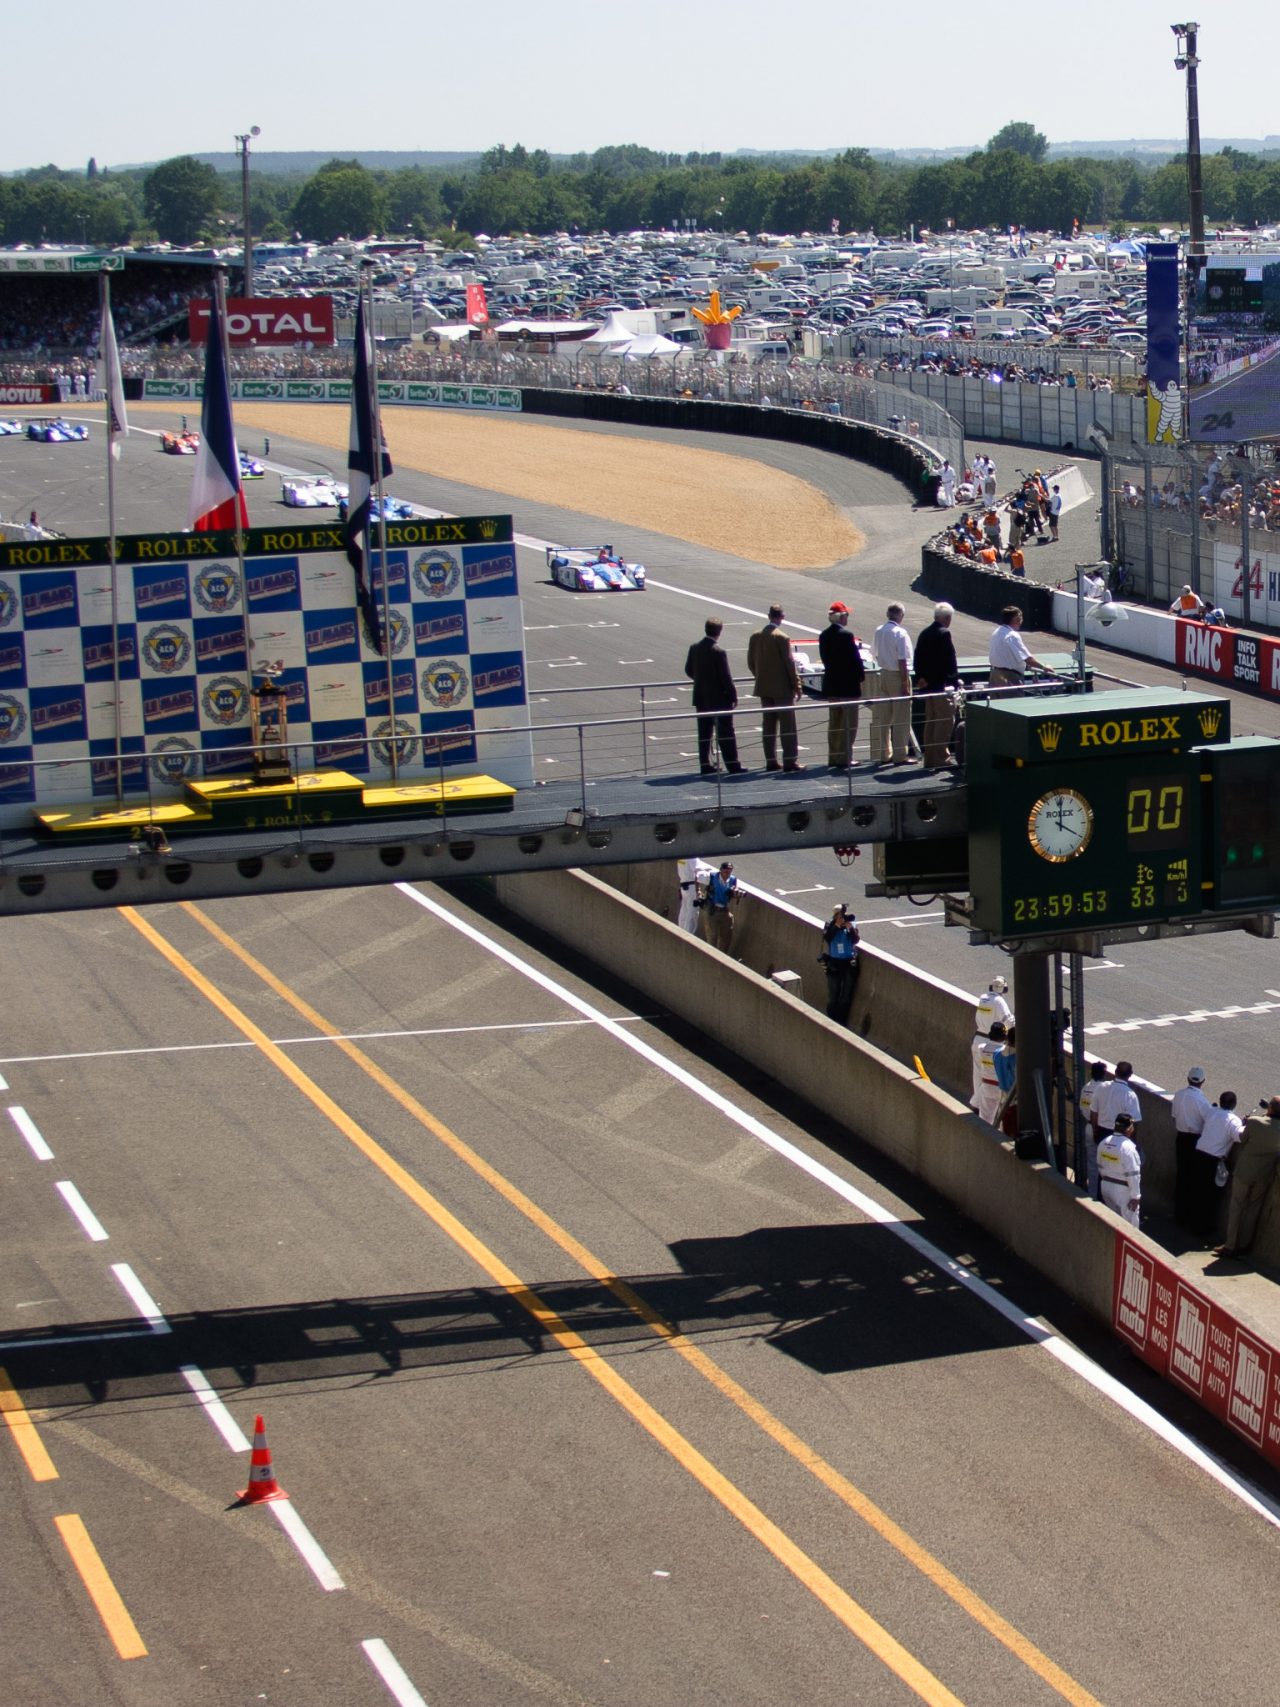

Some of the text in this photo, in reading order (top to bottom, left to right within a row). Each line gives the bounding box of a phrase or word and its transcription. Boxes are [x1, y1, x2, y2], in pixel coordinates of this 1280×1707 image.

[8, 523, 467, 565] ROLEX ROLEX ROLEX ROLEX
[1231, 556, 1264, 600] 24
[1184, 624, 1222, 673] RMC
[1238, 640, 1256, 655] INFO
[1238, 653, 1256, 669] TALK
[1234, 666, 1260, 683] SPORT
[1080, 716, 1181, 746] ROLEX
[286, 796, 292, 810] 1
[1046, 808, 1074, 818] ROLEX
[1127, 786, 1183, 834] 00
[264, 813, 314, 827] ROLEX
[1014, 890, 1107, 920] 23:59:53
[1131, 885, 1155, 908] 33
[1156, 1282, 1172, 1308] TOUS
[1120, 1303, 1144, 1338] moto
[1156, 1306, 1168, 1328] LES
[1152, 1326, 1168, 1352] MOIS
[1210, 1324, 1232, 1354] TOUTE
[1174, 1347, 1200, 1384] moto
[1208, 1346, 1230, 1377] L'INFO
[1207, 1372, 1226, 1398] AUTO
[1232, 1395, 1261, 1434] moto
